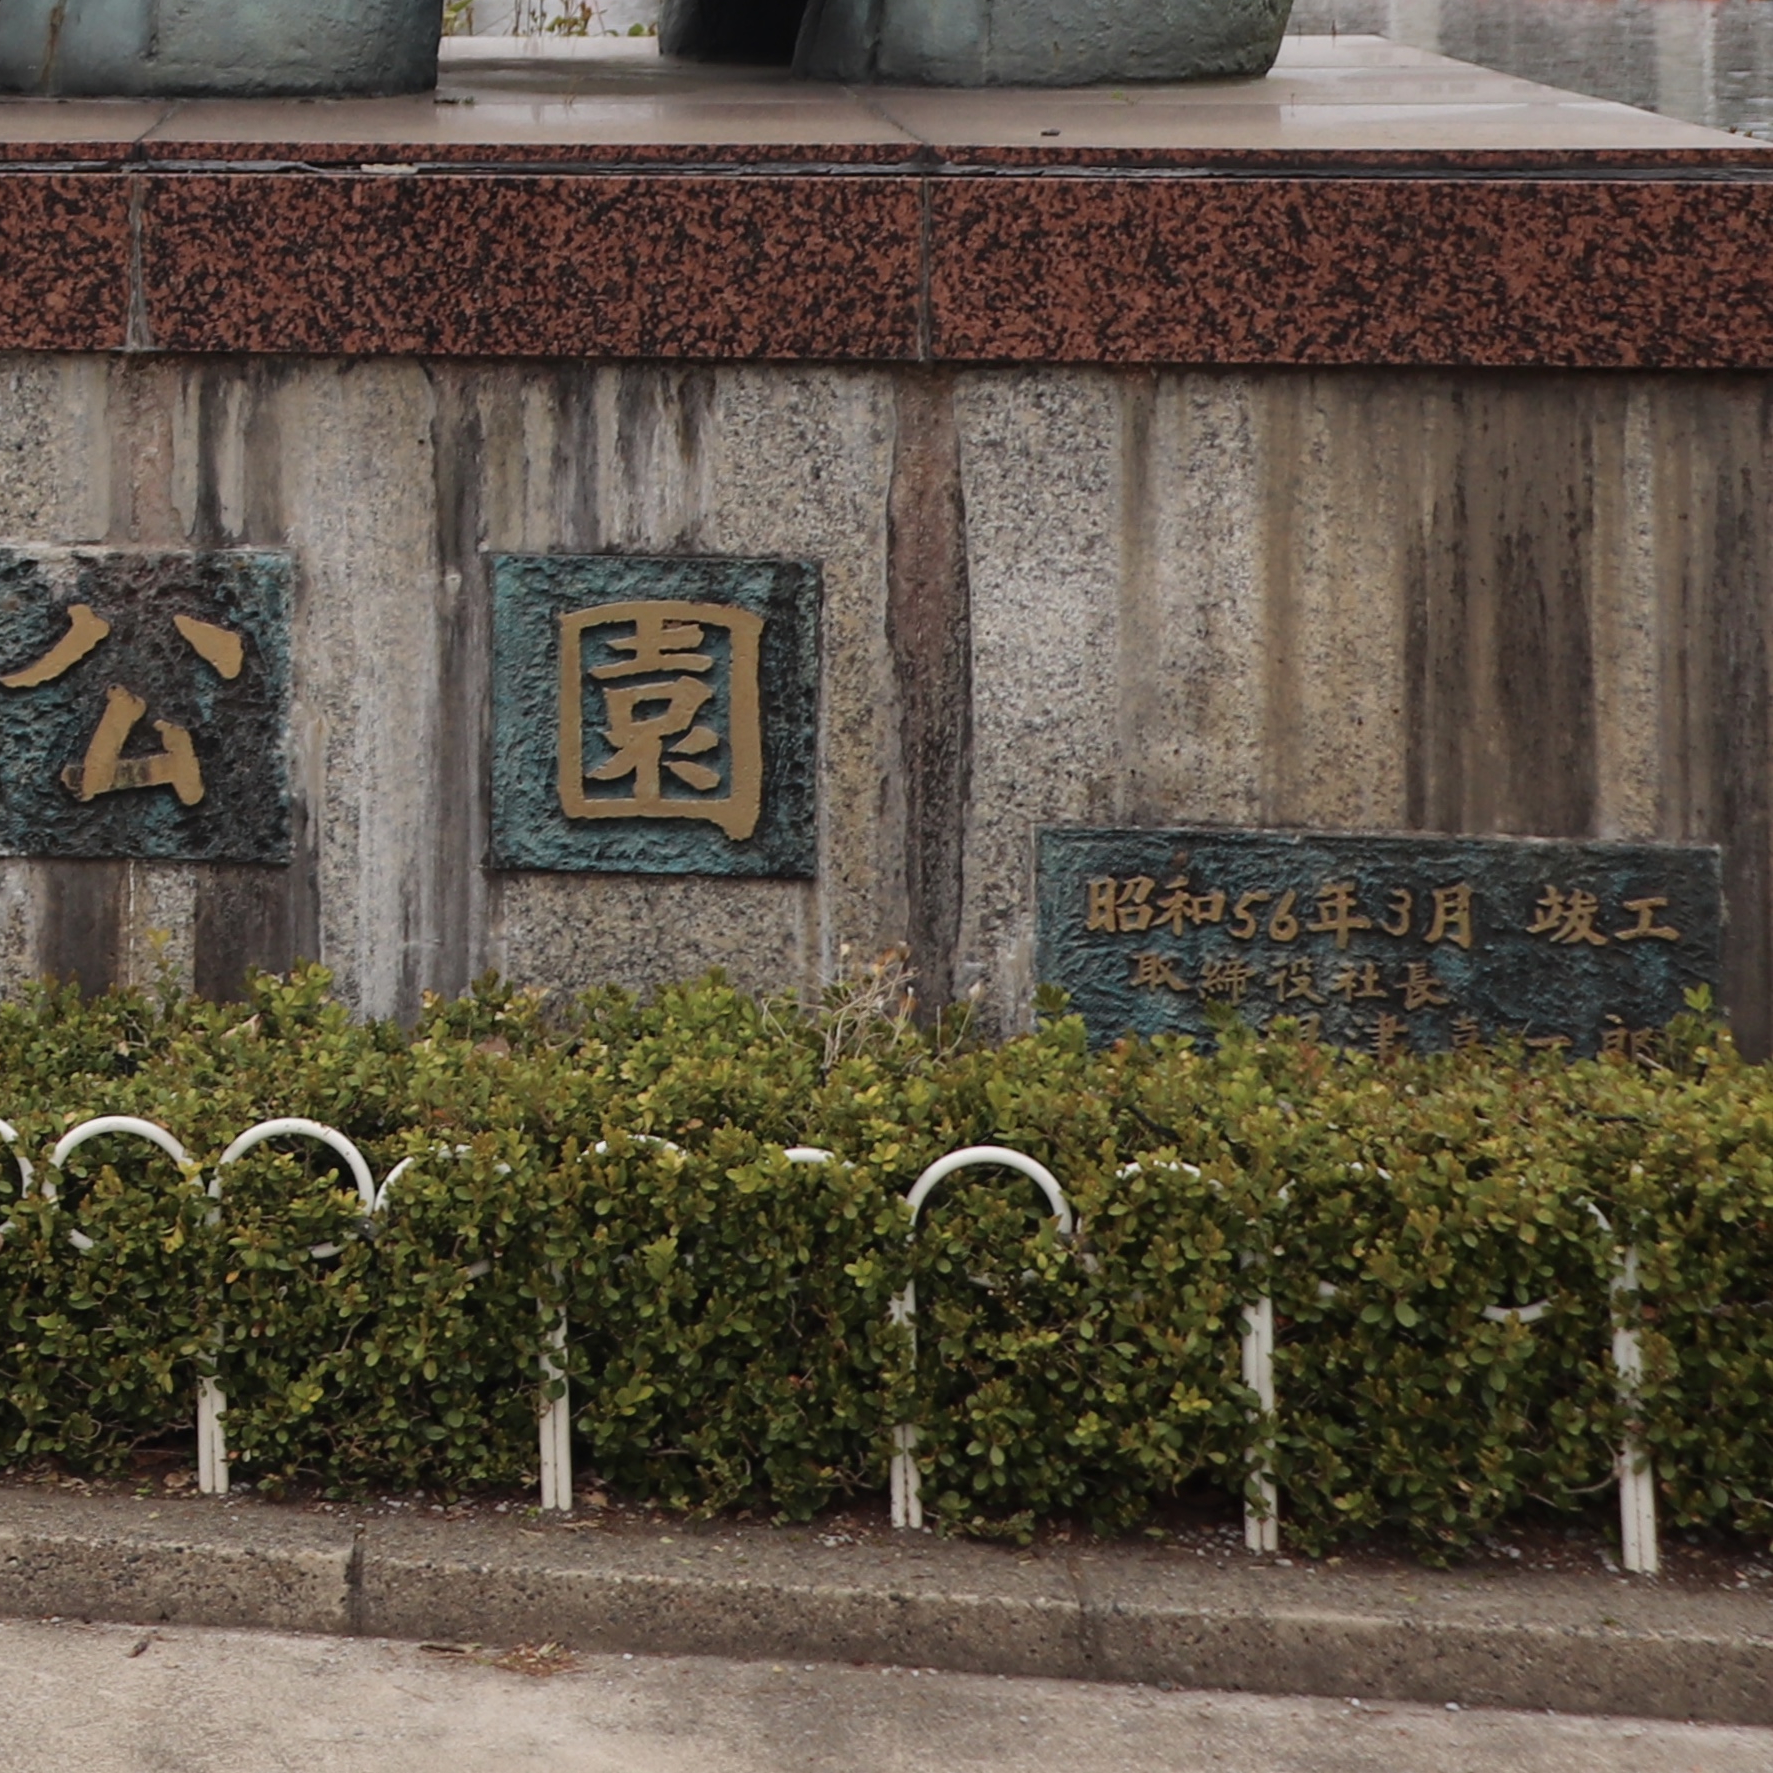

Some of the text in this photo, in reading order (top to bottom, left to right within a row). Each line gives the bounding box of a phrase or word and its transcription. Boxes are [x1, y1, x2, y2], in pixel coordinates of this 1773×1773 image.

[1129, 952, 1450, 1011] 取締役社長
